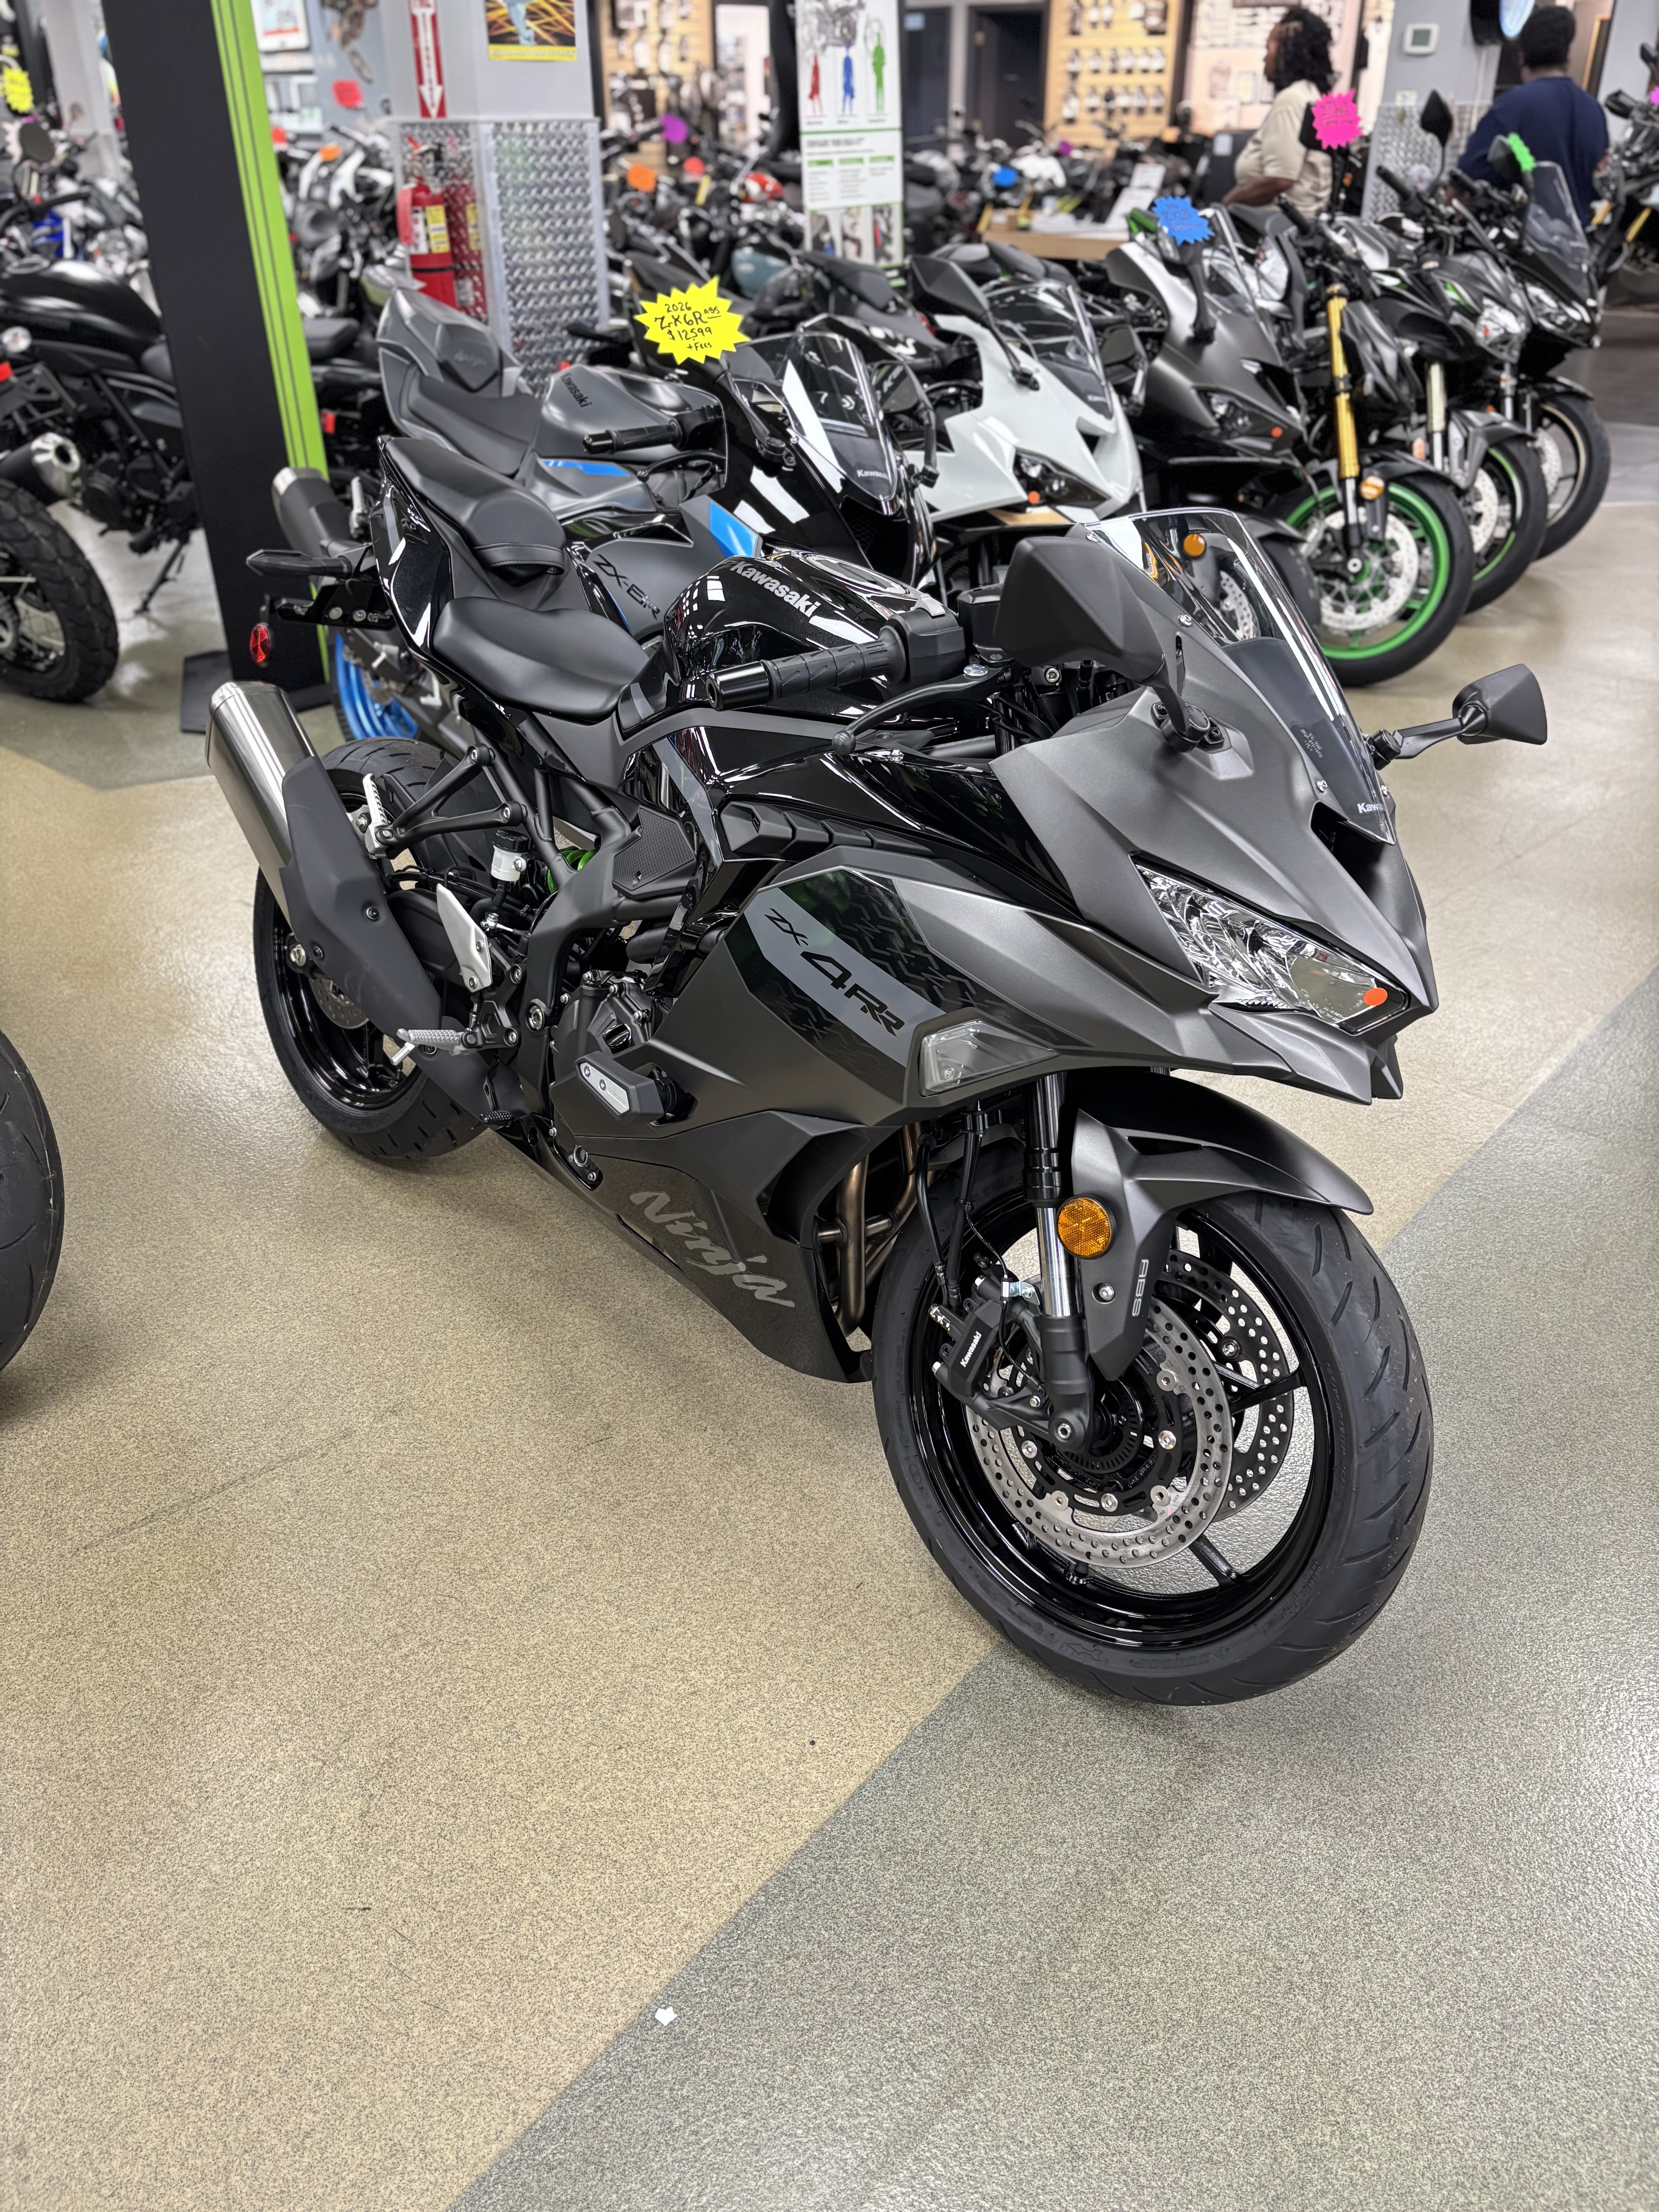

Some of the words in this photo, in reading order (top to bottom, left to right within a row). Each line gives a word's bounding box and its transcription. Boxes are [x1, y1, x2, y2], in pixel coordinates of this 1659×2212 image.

[654, 311, 708, 330] ZX6R
[665, 301, 692, 313] 2026
[560, 372, 593, 408] Kawasaki
[730, 561, 821, 618] Kawasaki
[629, 1190, 795, 1308] Ninja
[1132, 1259, 1149, 1317] ABS
[960, 1331, 982, 1368] Kawasaki
